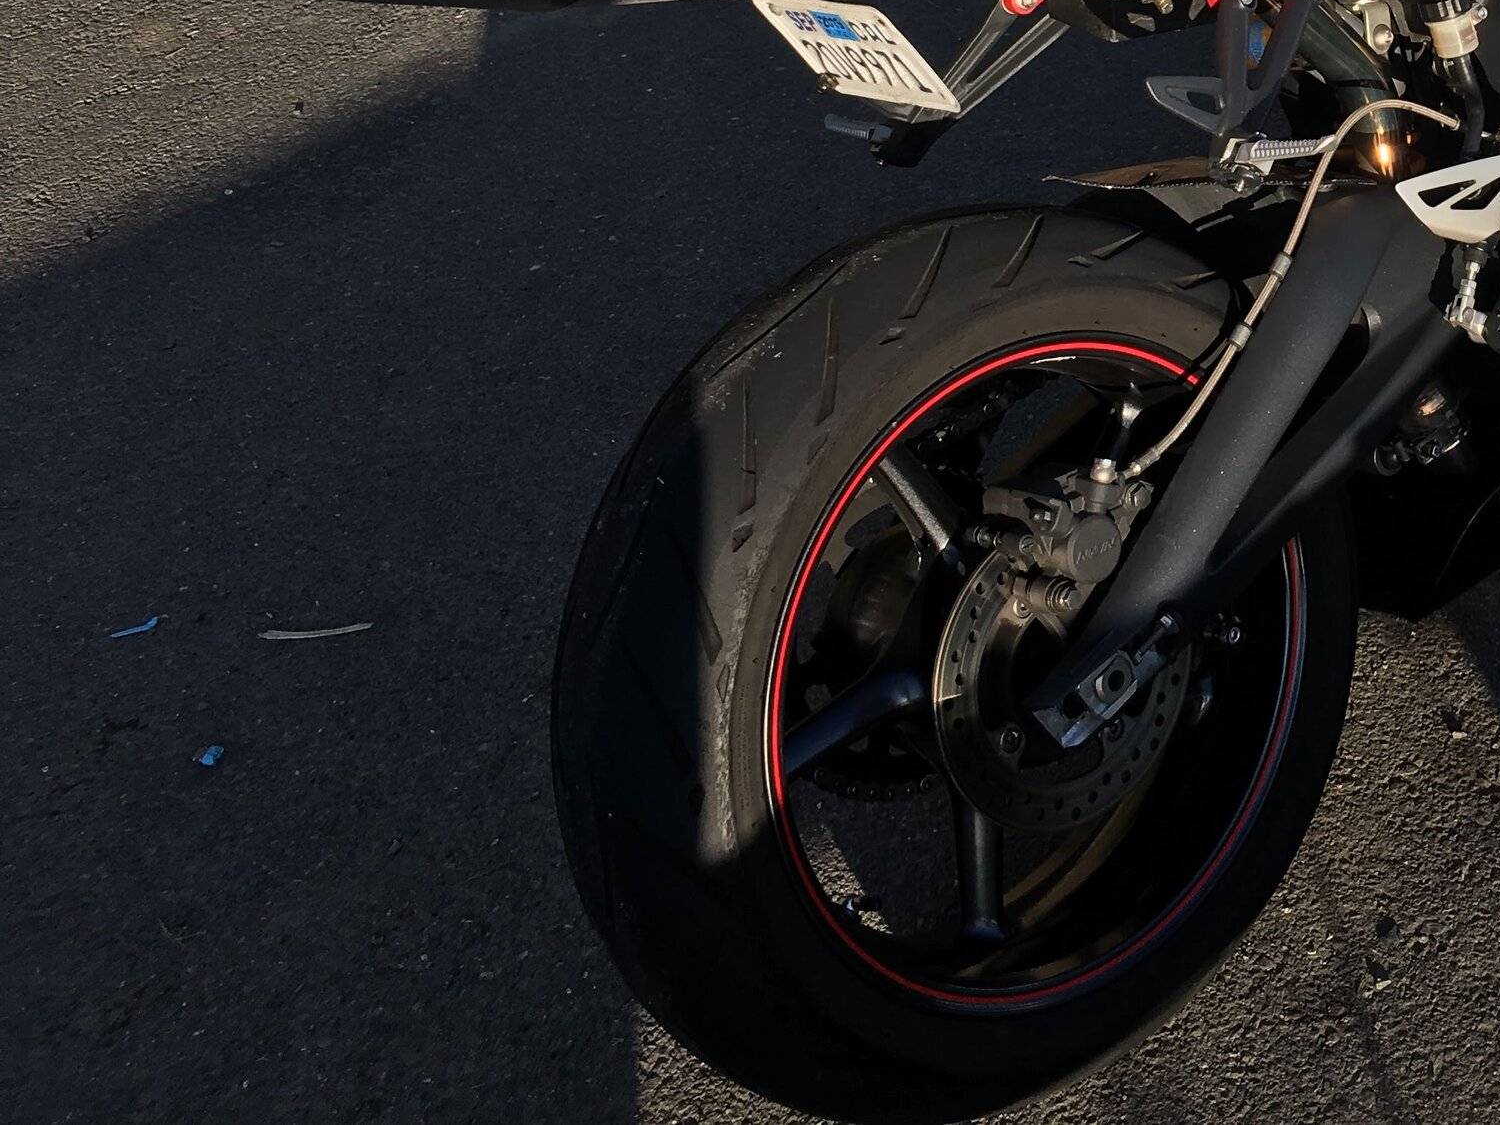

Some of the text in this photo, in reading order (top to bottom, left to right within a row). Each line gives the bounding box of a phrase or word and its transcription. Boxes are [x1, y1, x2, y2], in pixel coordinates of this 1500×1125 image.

[786, 10, 817, 32] SEP
[849, 21, 896, 45] CAL
[801, 39, 932, 94] 20V9971
